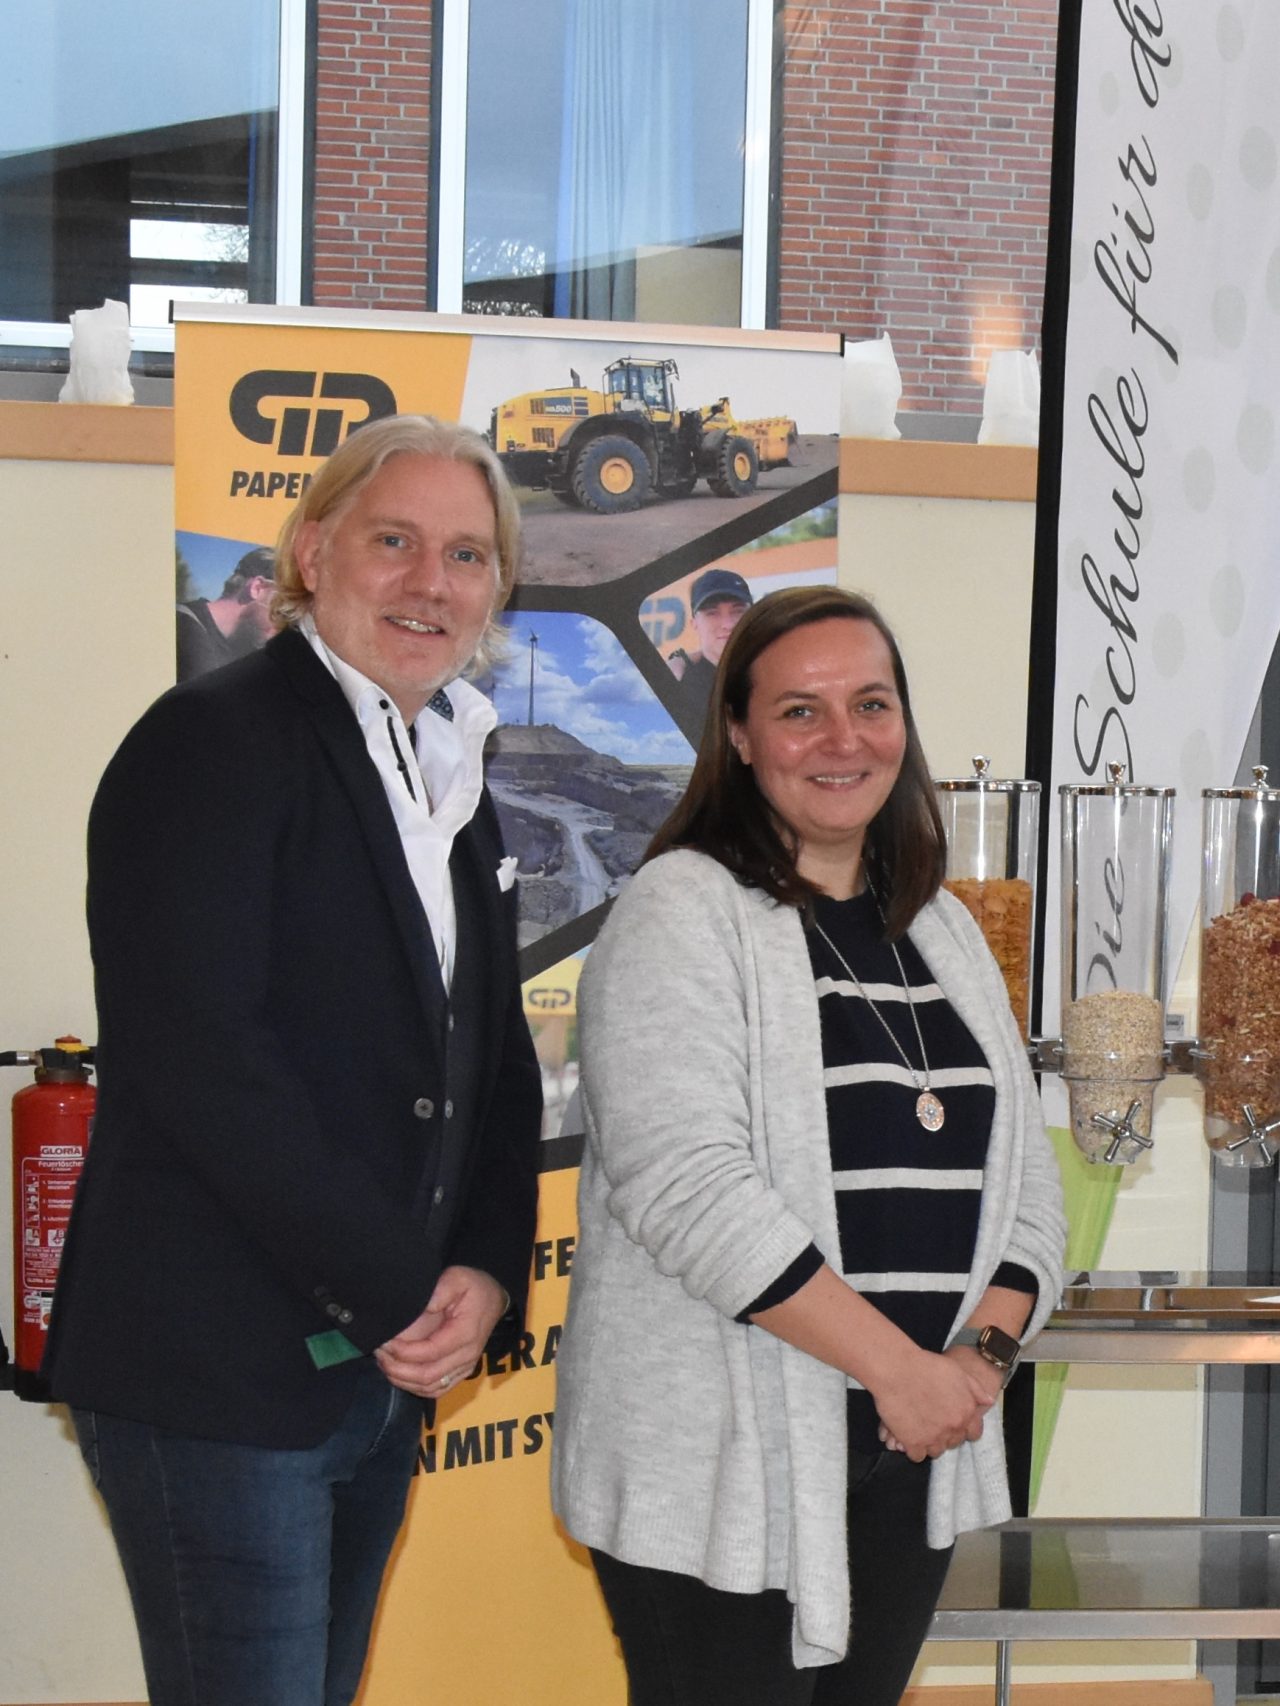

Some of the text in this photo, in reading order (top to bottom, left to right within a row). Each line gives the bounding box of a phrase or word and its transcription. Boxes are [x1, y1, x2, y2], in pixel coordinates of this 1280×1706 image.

[1074, 367, 1149, 816] Schule
[41, 1147, 81, 1155] GLORIA
[443, 1418, 519, 1471] MIT
